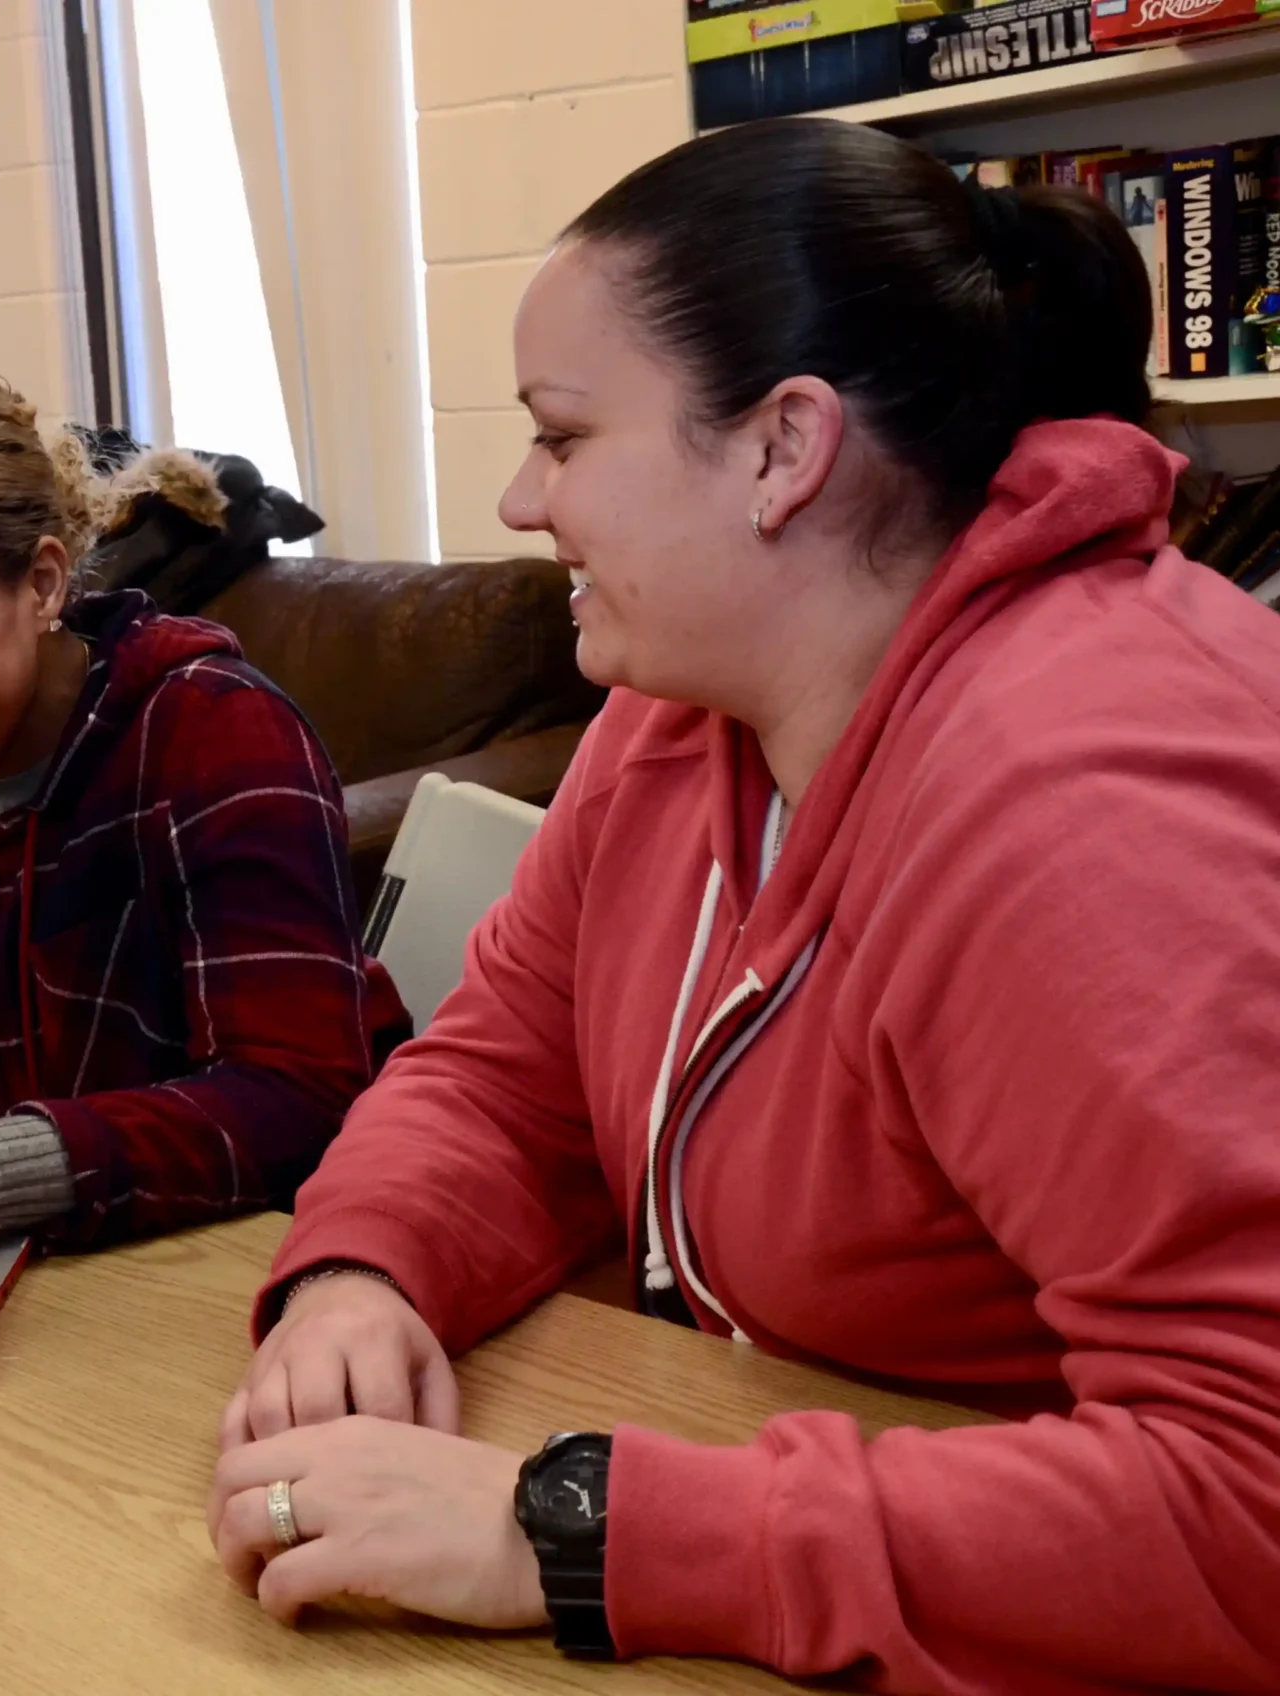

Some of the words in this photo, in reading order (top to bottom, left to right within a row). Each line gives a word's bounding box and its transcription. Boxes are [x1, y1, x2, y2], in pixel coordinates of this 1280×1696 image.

[929, 9, 1092, 81] TTLESHIP
[1183, 174, 1212, 309] WINDOWS
[1266, 213, 1280, 242] RED
[1185, 315, 1213, 349] 98
